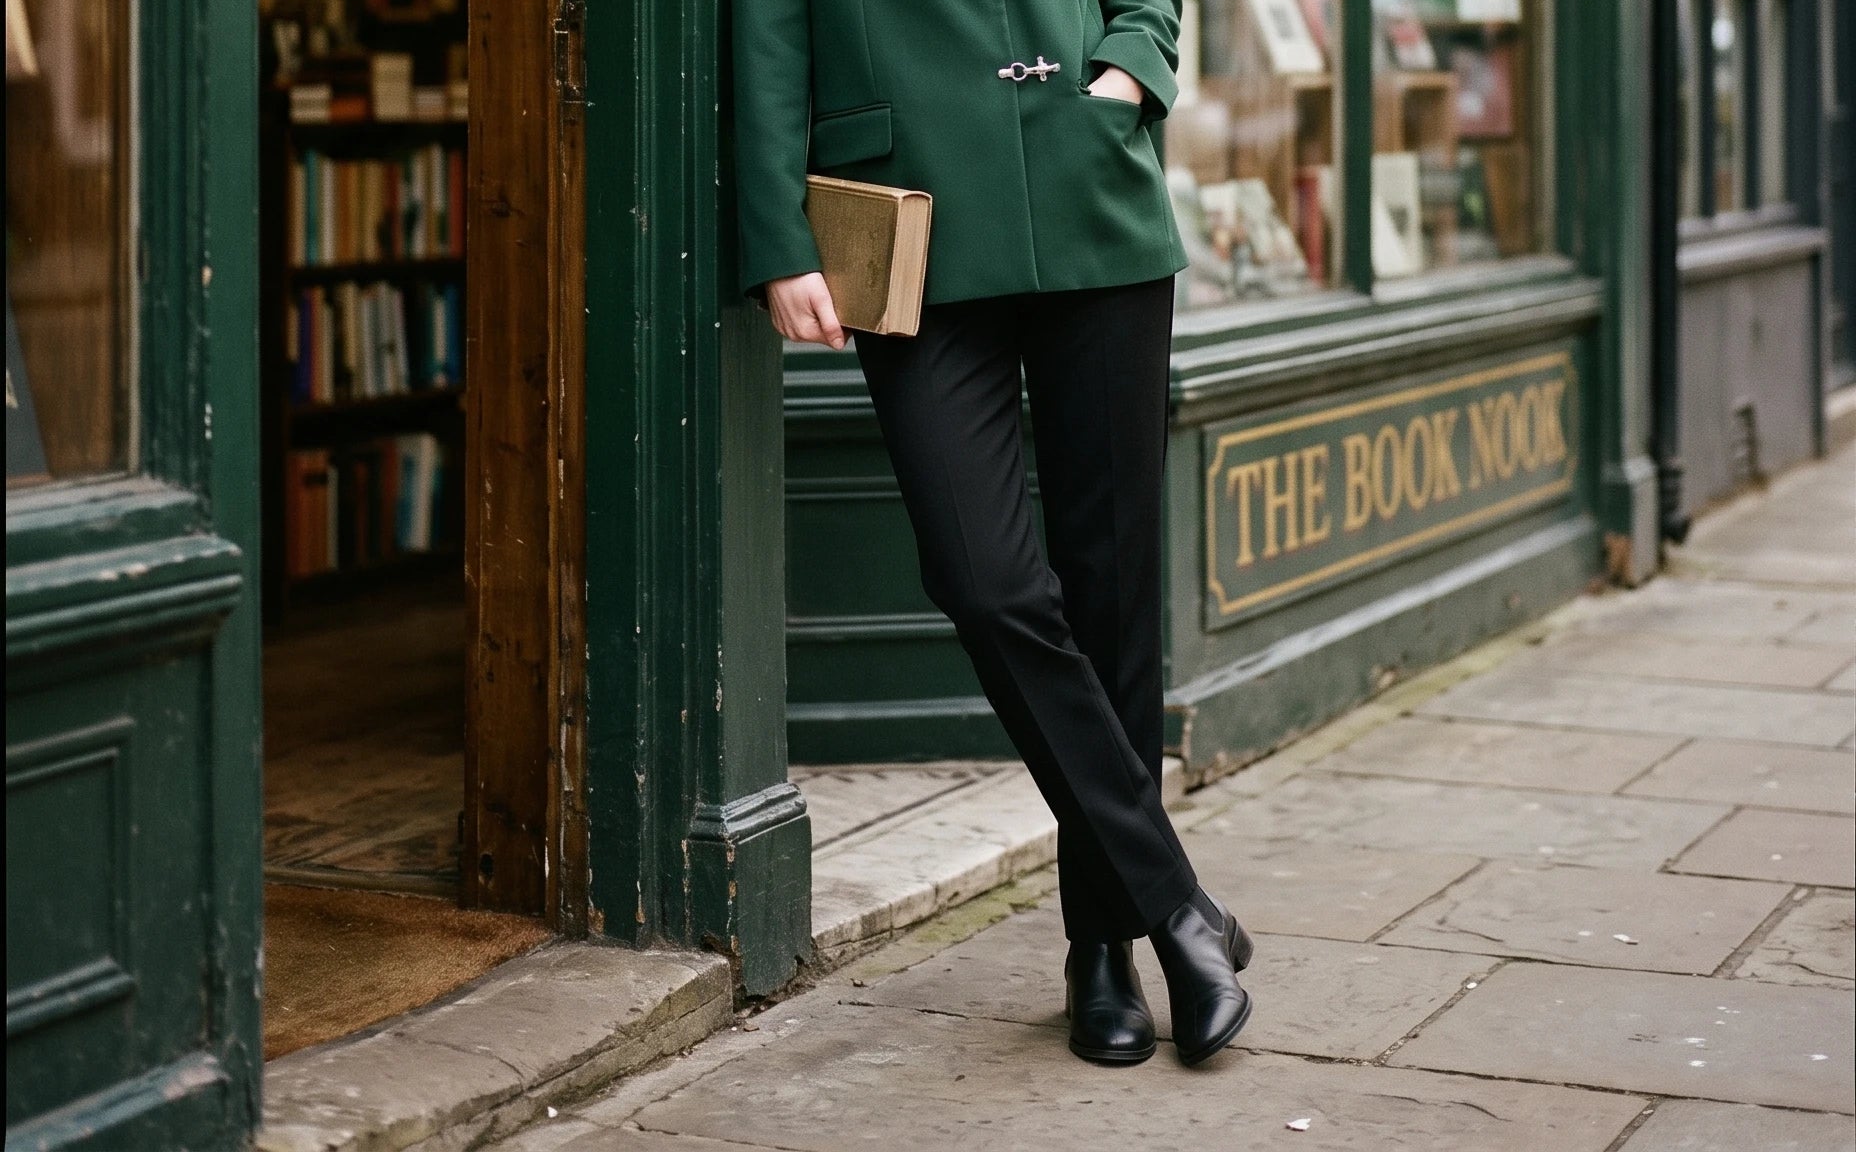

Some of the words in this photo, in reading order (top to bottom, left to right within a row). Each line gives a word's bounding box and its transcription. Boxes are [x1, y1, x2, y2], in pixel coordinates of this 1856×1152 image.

[1227, 445, 1331, 568] THE
[1342, 406, 1462, 533] BOOK
[1467, 380, 1567, 489] NOOK
